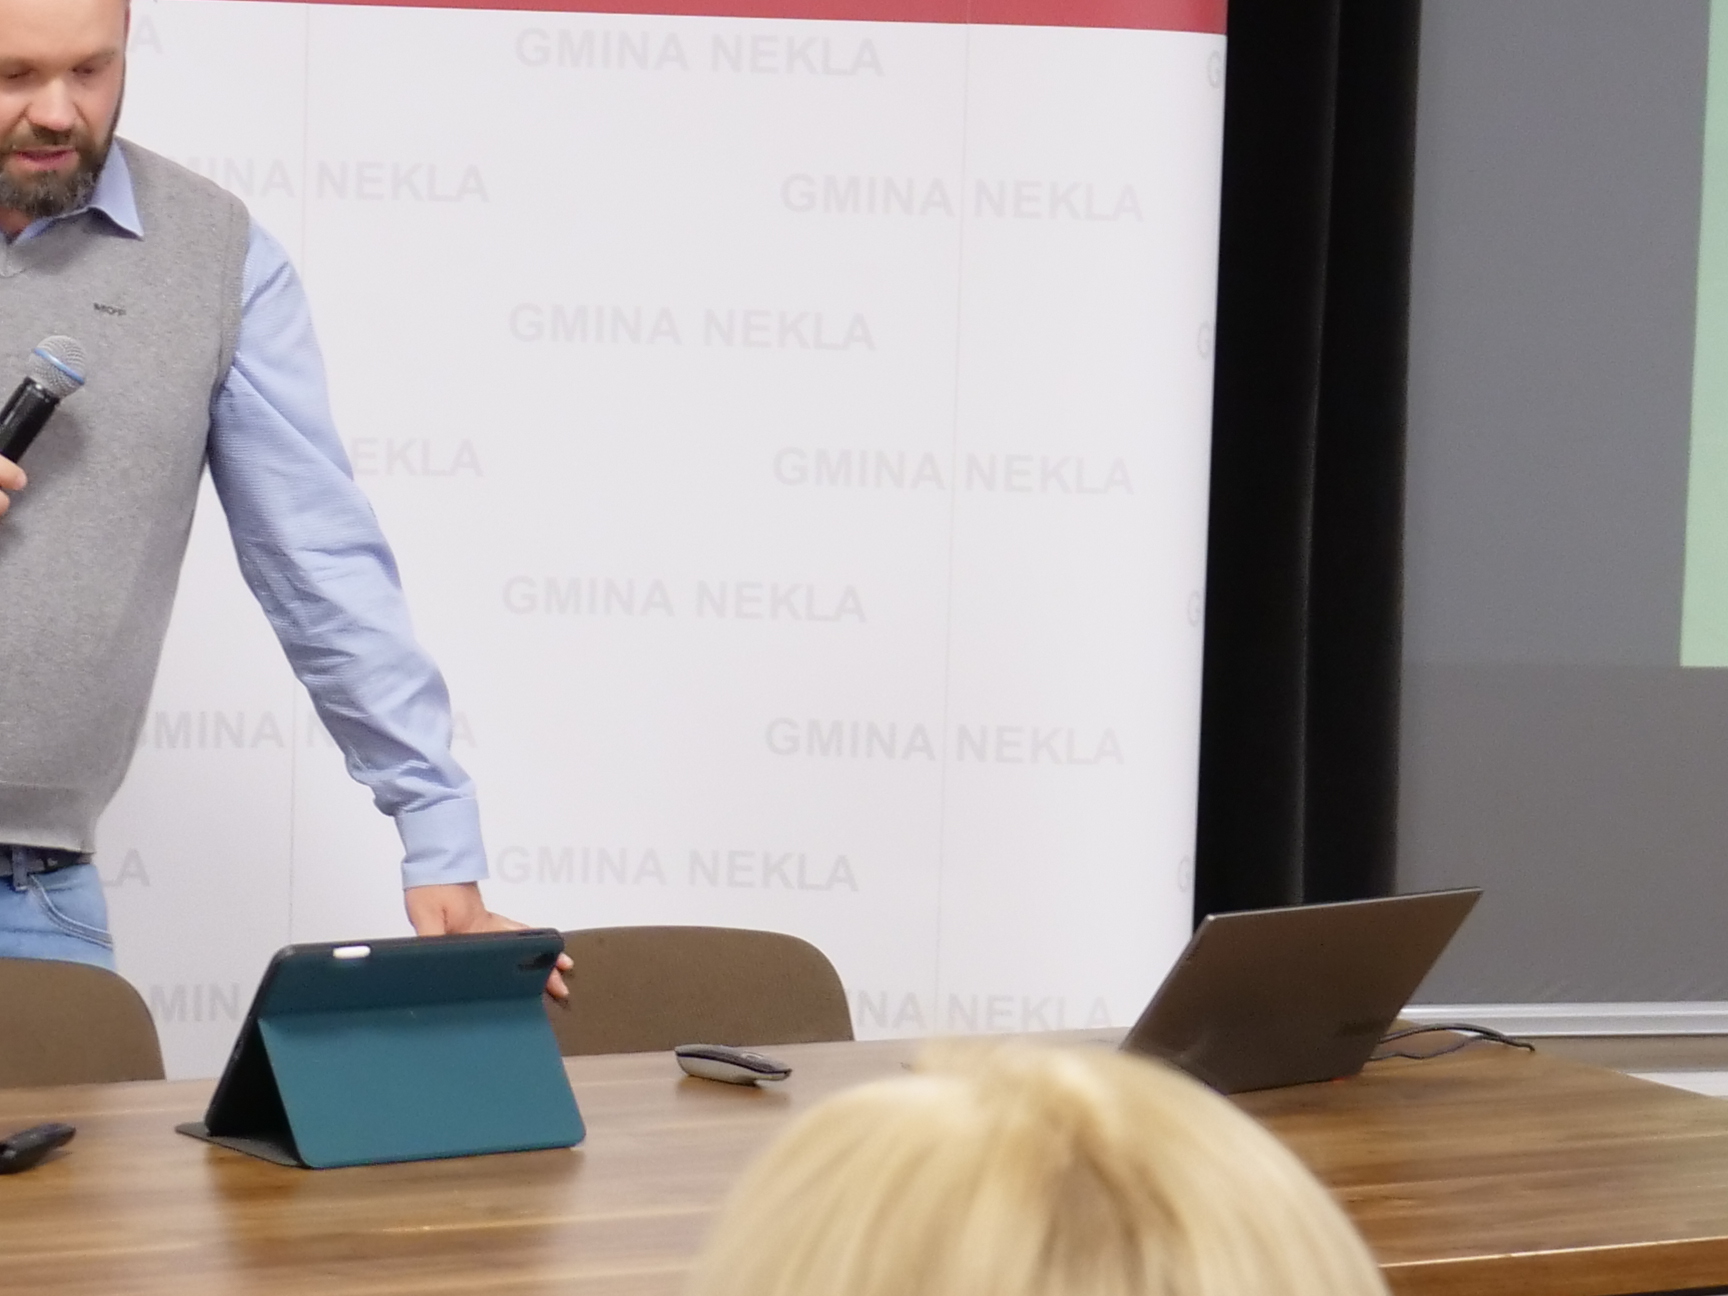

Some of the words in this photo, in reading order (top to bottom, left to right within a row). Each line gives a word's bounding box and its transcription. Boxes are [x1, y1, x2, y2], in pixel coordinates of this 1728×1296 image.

[515, 27, 689, 71] GMINA
[711, 34, 885, 77] NEKLA
[317, 161, 490, 203] NEKLA
[781, 173, 954, 217] GMINA
[975, 179, 1144, 222] NEKLA
[509, 303, 682, 345] GMINA
[704, 309, 876, 351] NEKLA
[350, 436, 484, 477] EKLA
[773, 447, 945, 490] GMINA
[965, 453, 1133, 494] NEKLA
[502, 576, 674, 617] GMINA
[696, 580, 867, 624] NEKLA
[765, 718, 936, 761] GMINA
[956, 724, 1124, 765] NEKLA
[495, 845, 667, 886] GMINA
[689, 849, 859, 892] NEKLA
